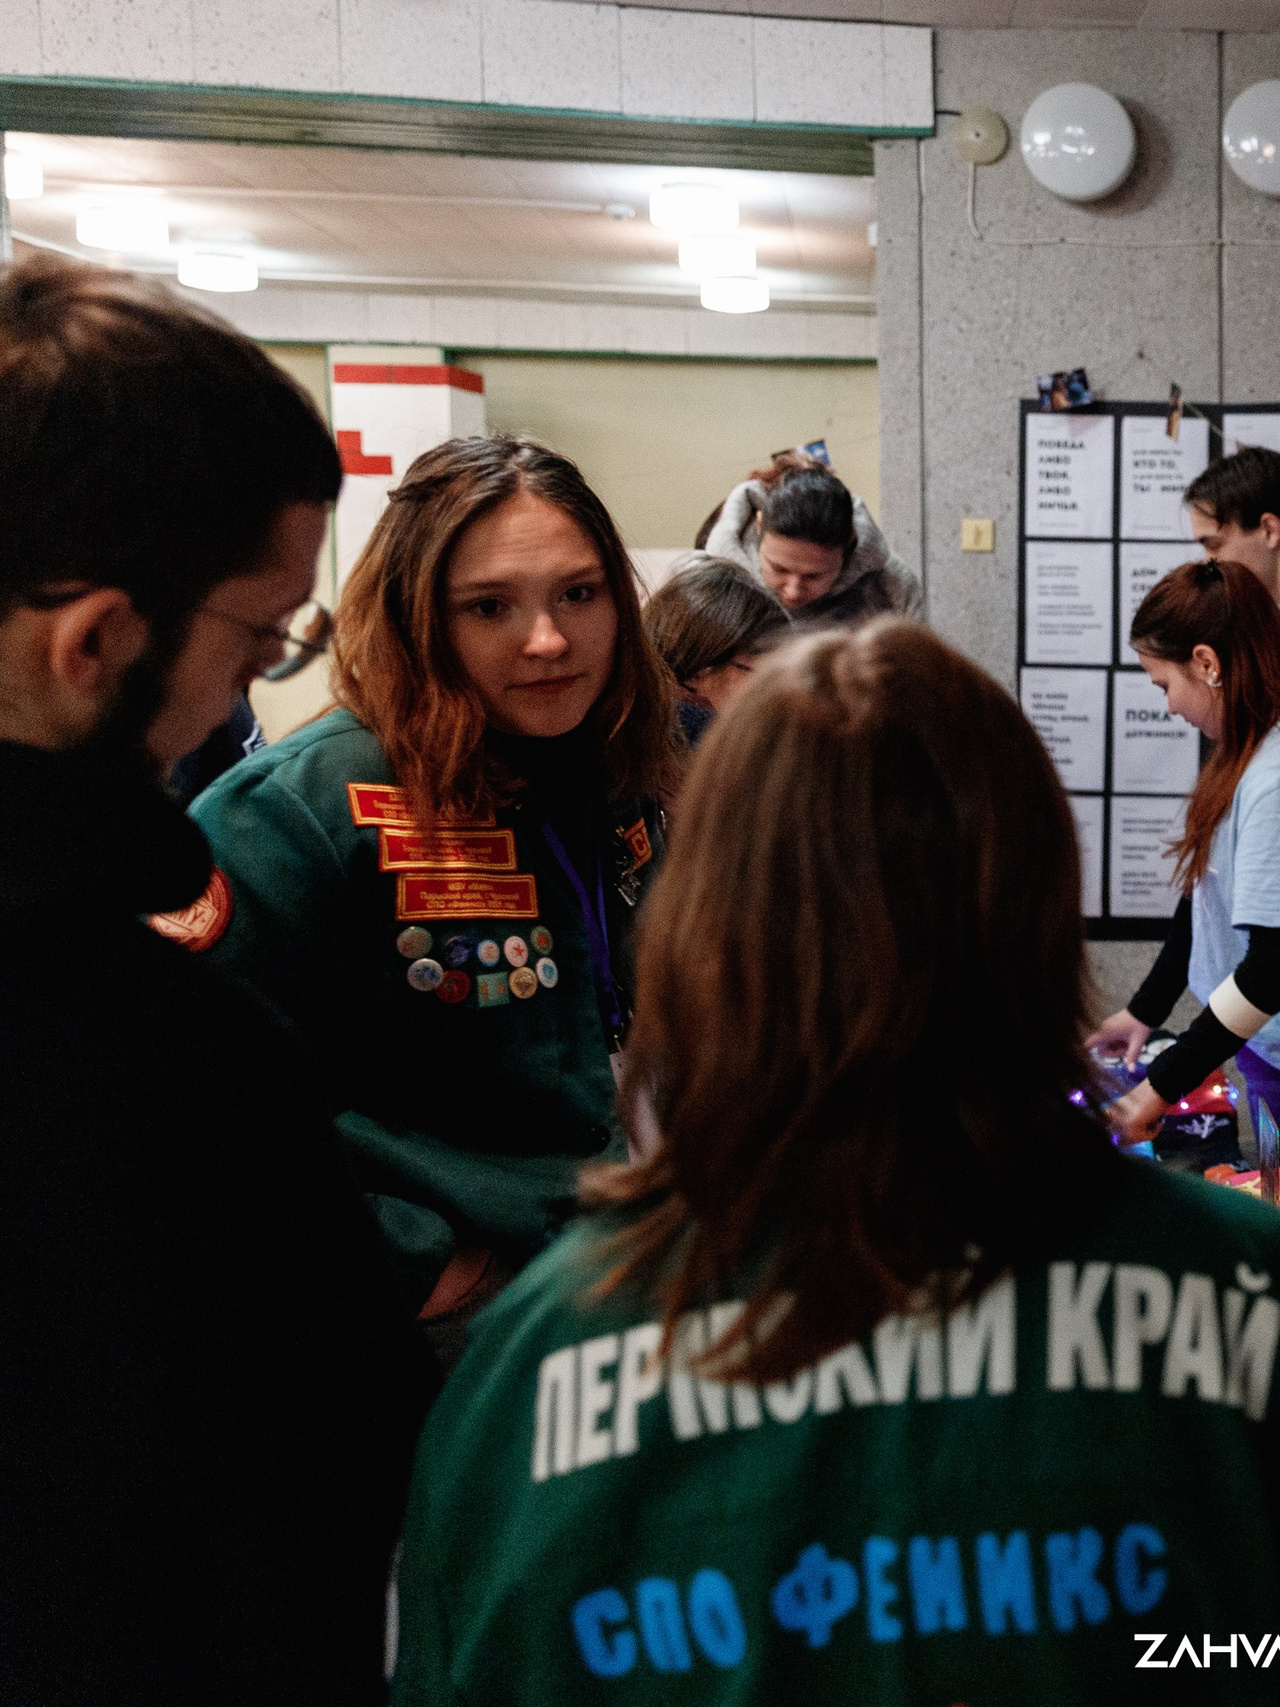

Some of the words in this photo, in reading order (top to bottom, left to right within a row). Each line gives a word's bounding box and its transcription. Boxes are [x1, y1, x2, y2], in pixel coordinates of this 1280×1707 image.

[1038, 439, 1084, 449] ПОБЕДА
[1125, 708, 1171, 723] ПОКА
[571, 1566, 748, 1678] СПО
[770, 1521, 1169, 1650] ФЕНИКС
